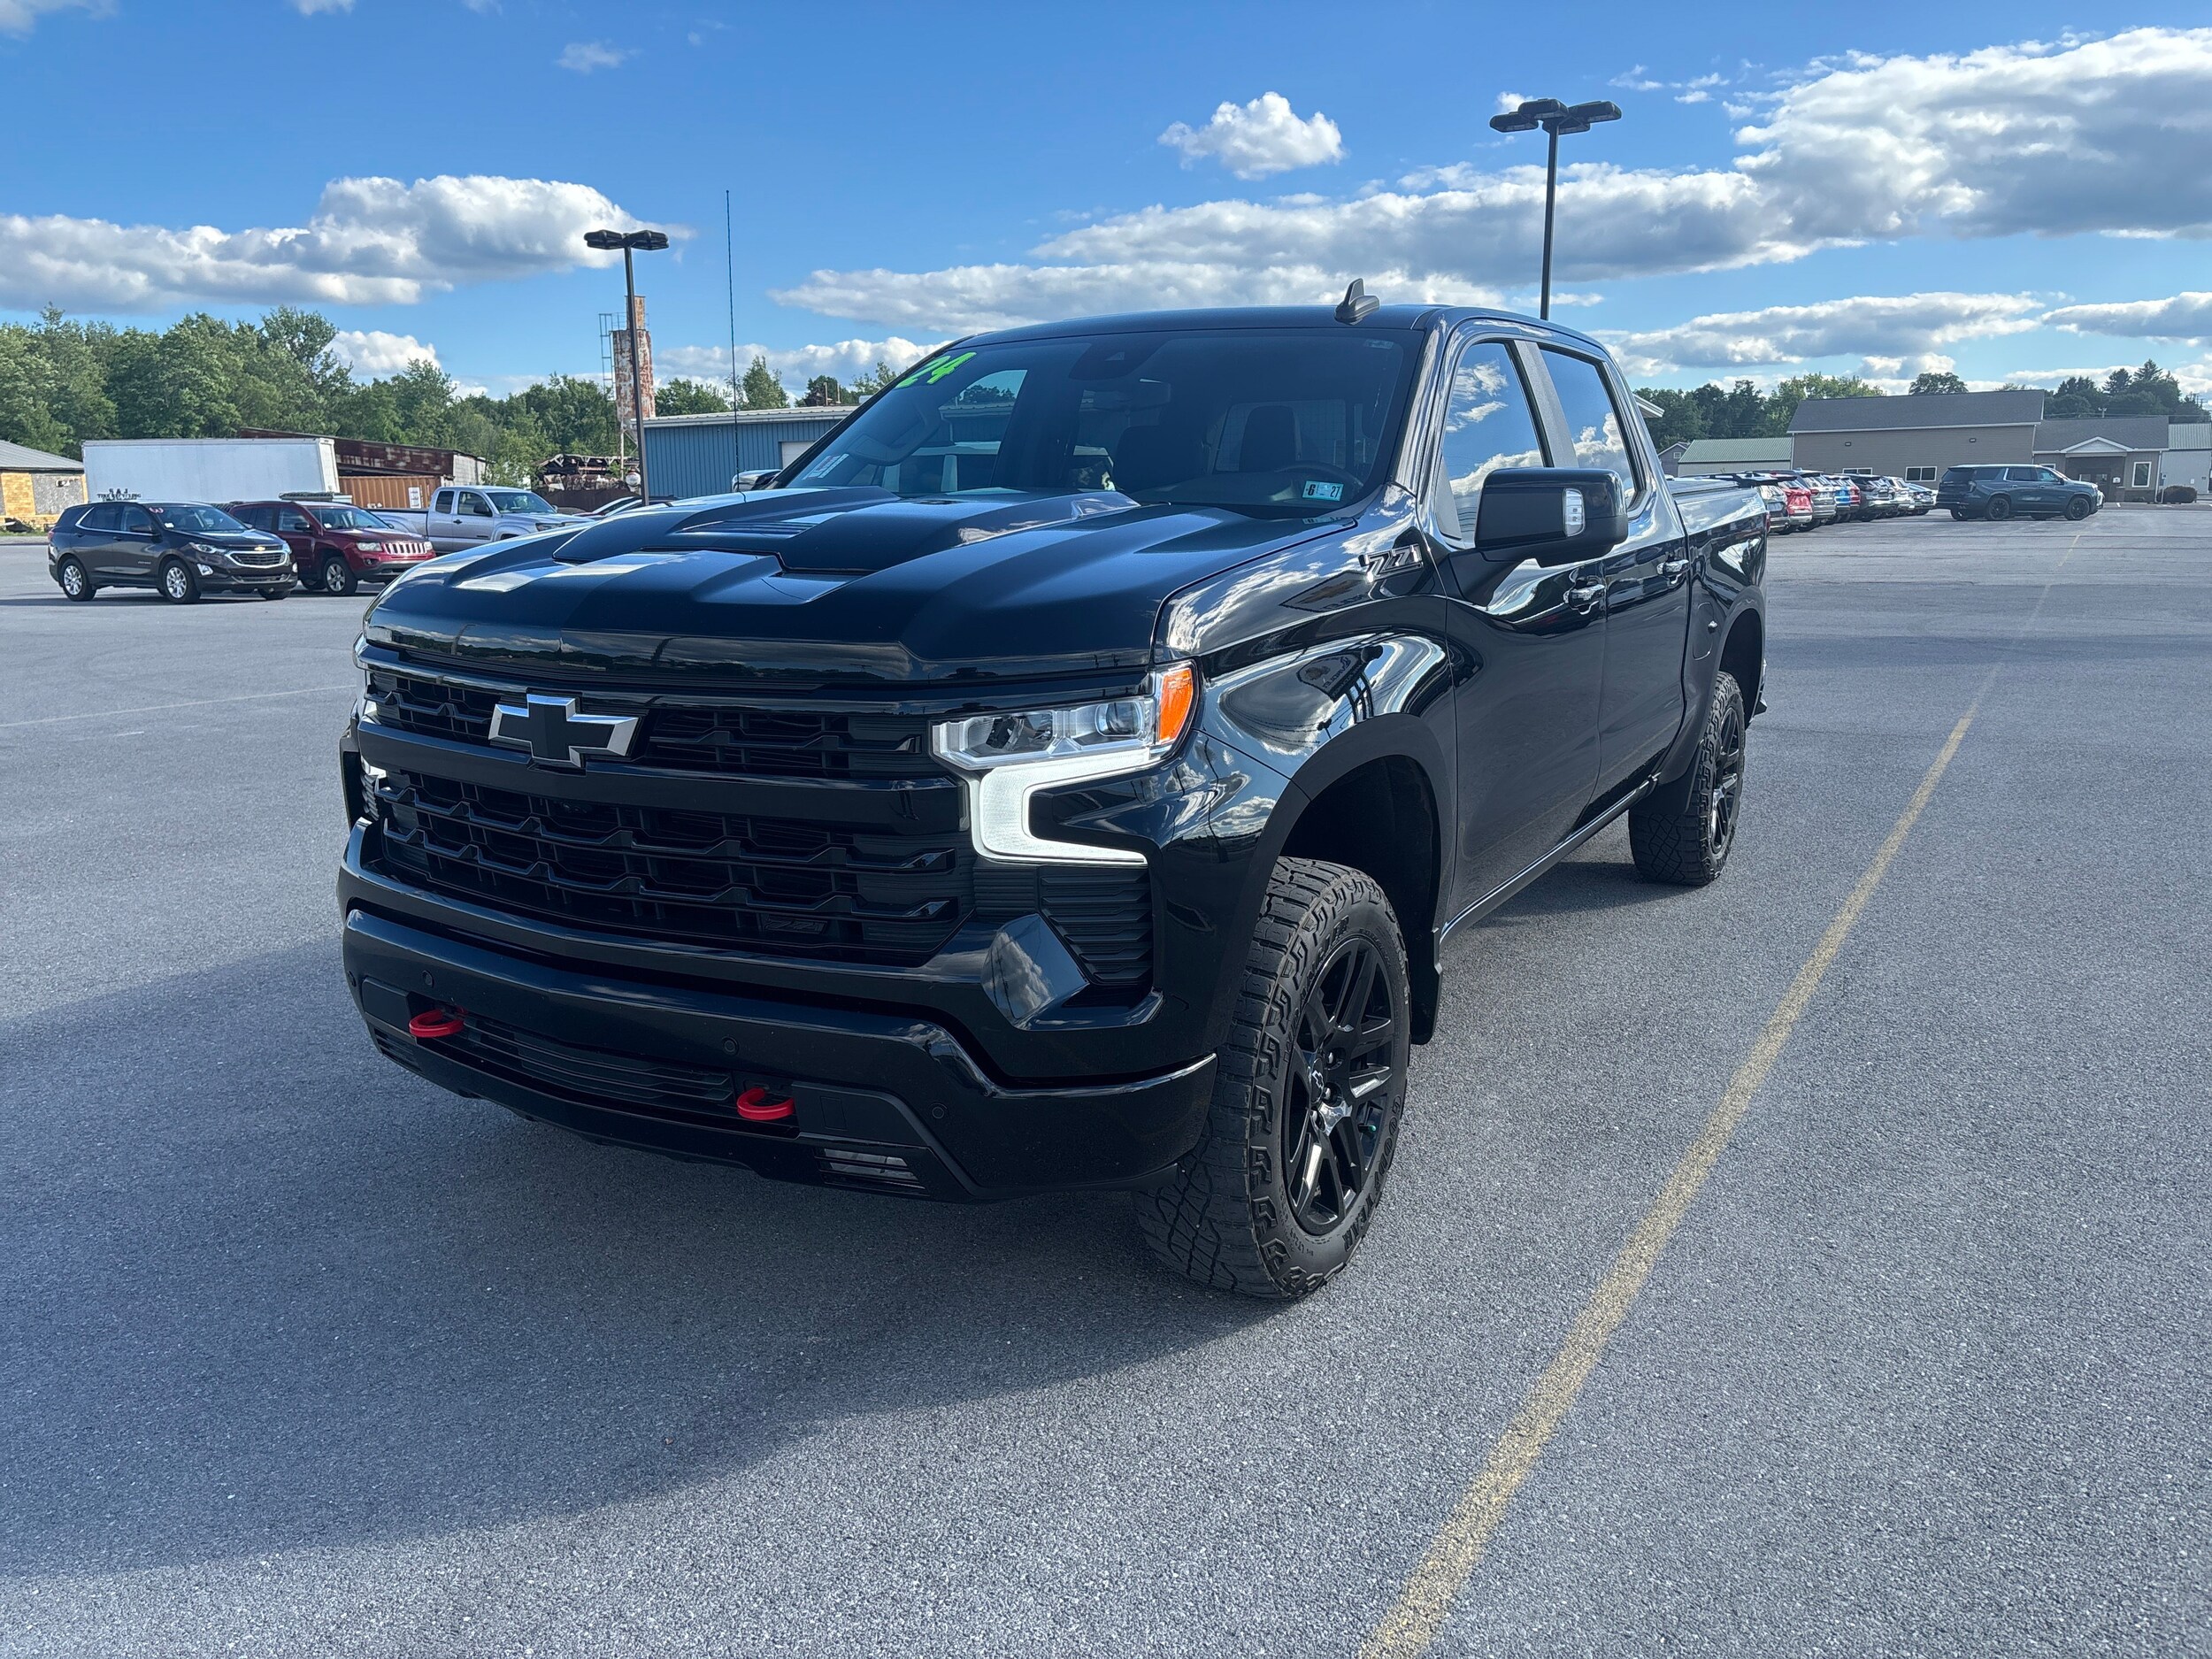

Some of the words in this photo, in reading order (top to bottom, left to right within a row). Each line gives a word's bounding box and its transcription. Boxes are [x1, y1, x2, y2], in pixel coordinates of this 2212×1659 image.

[894, 351, 978, 389] 24
[1307, 484, 1316, 495] 6
[1330, 485, 1340, 499] 27
[1358, 543, 1424, 582] Z71
[1341, 1094, 1403, 1254] GOODYEAR
